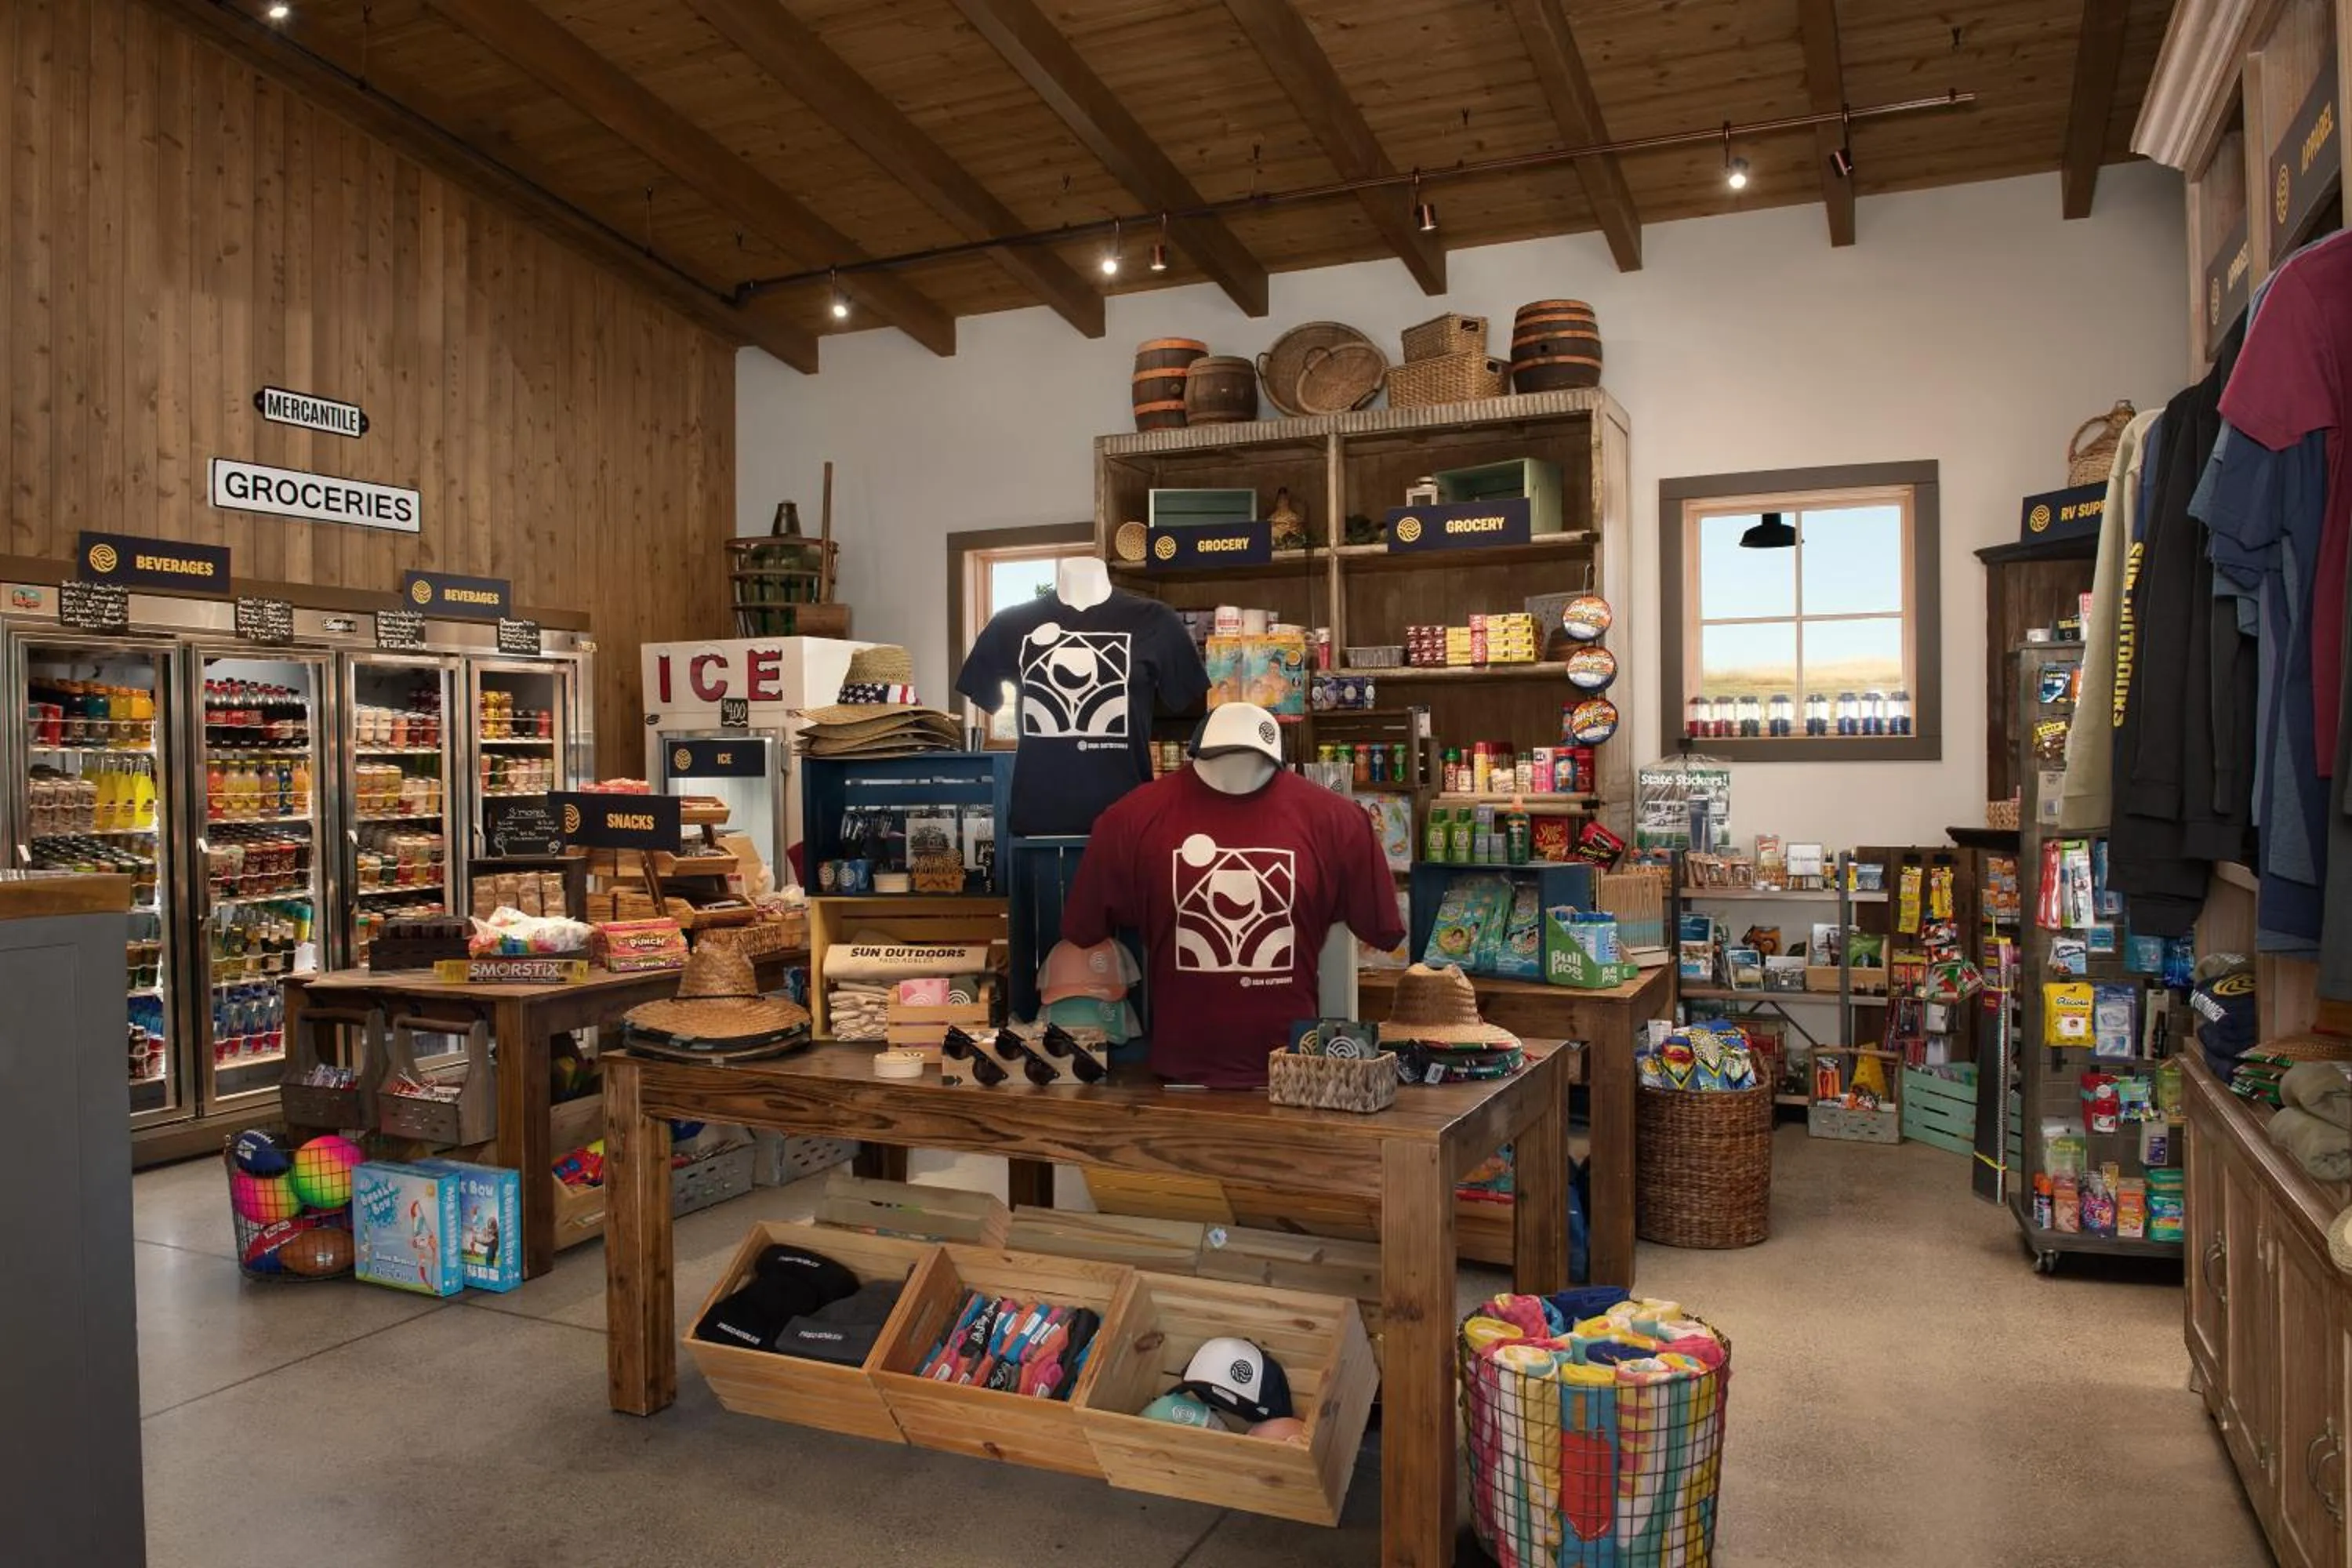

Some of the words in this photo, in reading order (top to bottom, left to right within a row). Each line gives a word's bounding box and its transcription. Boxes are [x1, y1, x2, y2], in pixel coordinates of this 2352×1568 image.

[266, 392, 358, 432] MERCANTILE
[224, 471, 413, 522] GROCERIES
[2060, 505, 2076, 522] RV
[1446, 516, 1505, 534] GROCERY
[1197, 537, 1250, 554] GROCERY
[135, 554, 214, 577] BEVERAGES
[444, 588, 500, 605] BEVERAGES
[657, 644, 783, 703] ICE
[717, 753, 733, 764] ICE
[1640, 774, 1673, 785] State
[1675, 773, 1727, 786] Stickers!
[607, 812, 655, 831] SNACKS
[850, 947, 881, 957] SUN
[884, 948, 967, 958] OUTDOORS
[2056, 996, 2090, 1007] Ricola
